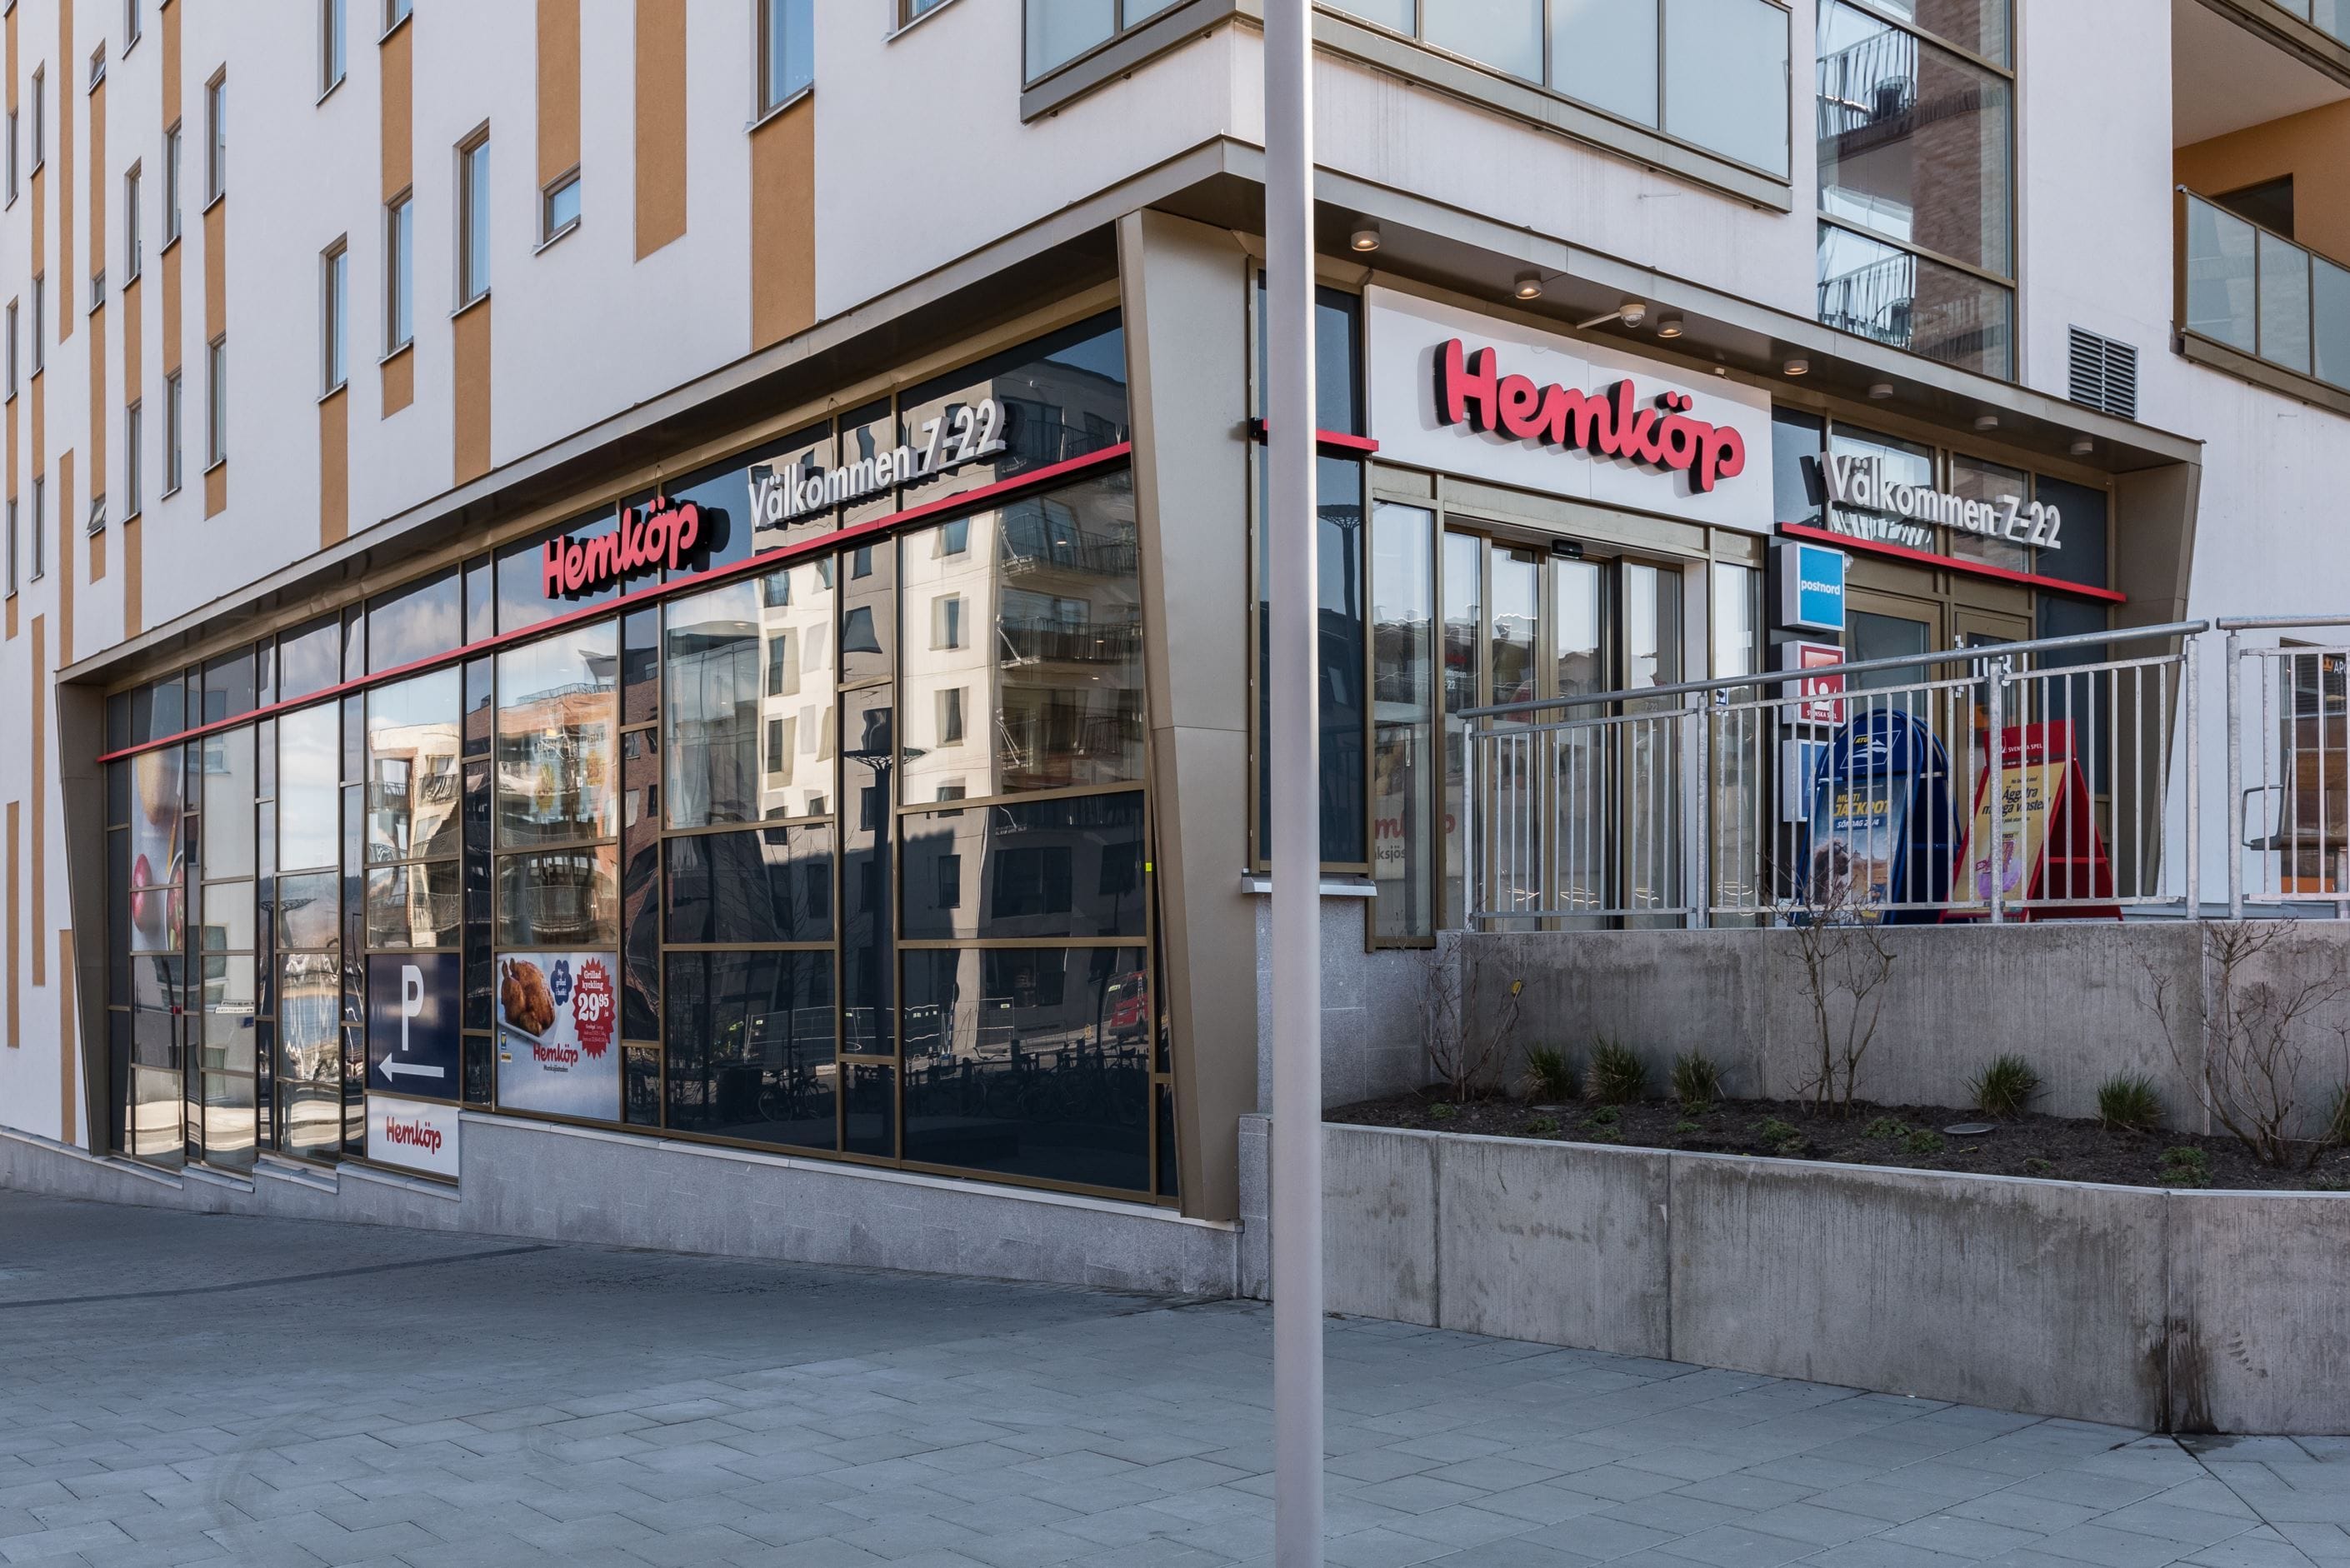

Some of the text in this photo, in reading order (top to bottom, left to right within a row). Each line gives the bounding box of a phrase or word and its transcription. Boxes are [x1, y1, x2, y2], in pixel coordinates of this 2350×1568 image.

[1438, 337, 1745, 492] Hemköp
[748, 399, 1006, 528] Välkommen 7-22
[1821, 451, 2061, 549] Välkommen 7-22
[542, 497, 698, 599] Hemköp
[1801, 580, 1840, 595] postnord
[1837, 793, 1860, 802] MUTI
[2002, 786, 2038, 804] Äggtra
[1864, 818, 1879, 826] 2/4
[582, 981, 604, 991] kyckling
[583, 971, 602, 979] Grillad
[402, 965, 424, 1051] P
[533, 1043, 578, 1067] Hemköp
[386, 1116, 442, 1155] Hemköp
